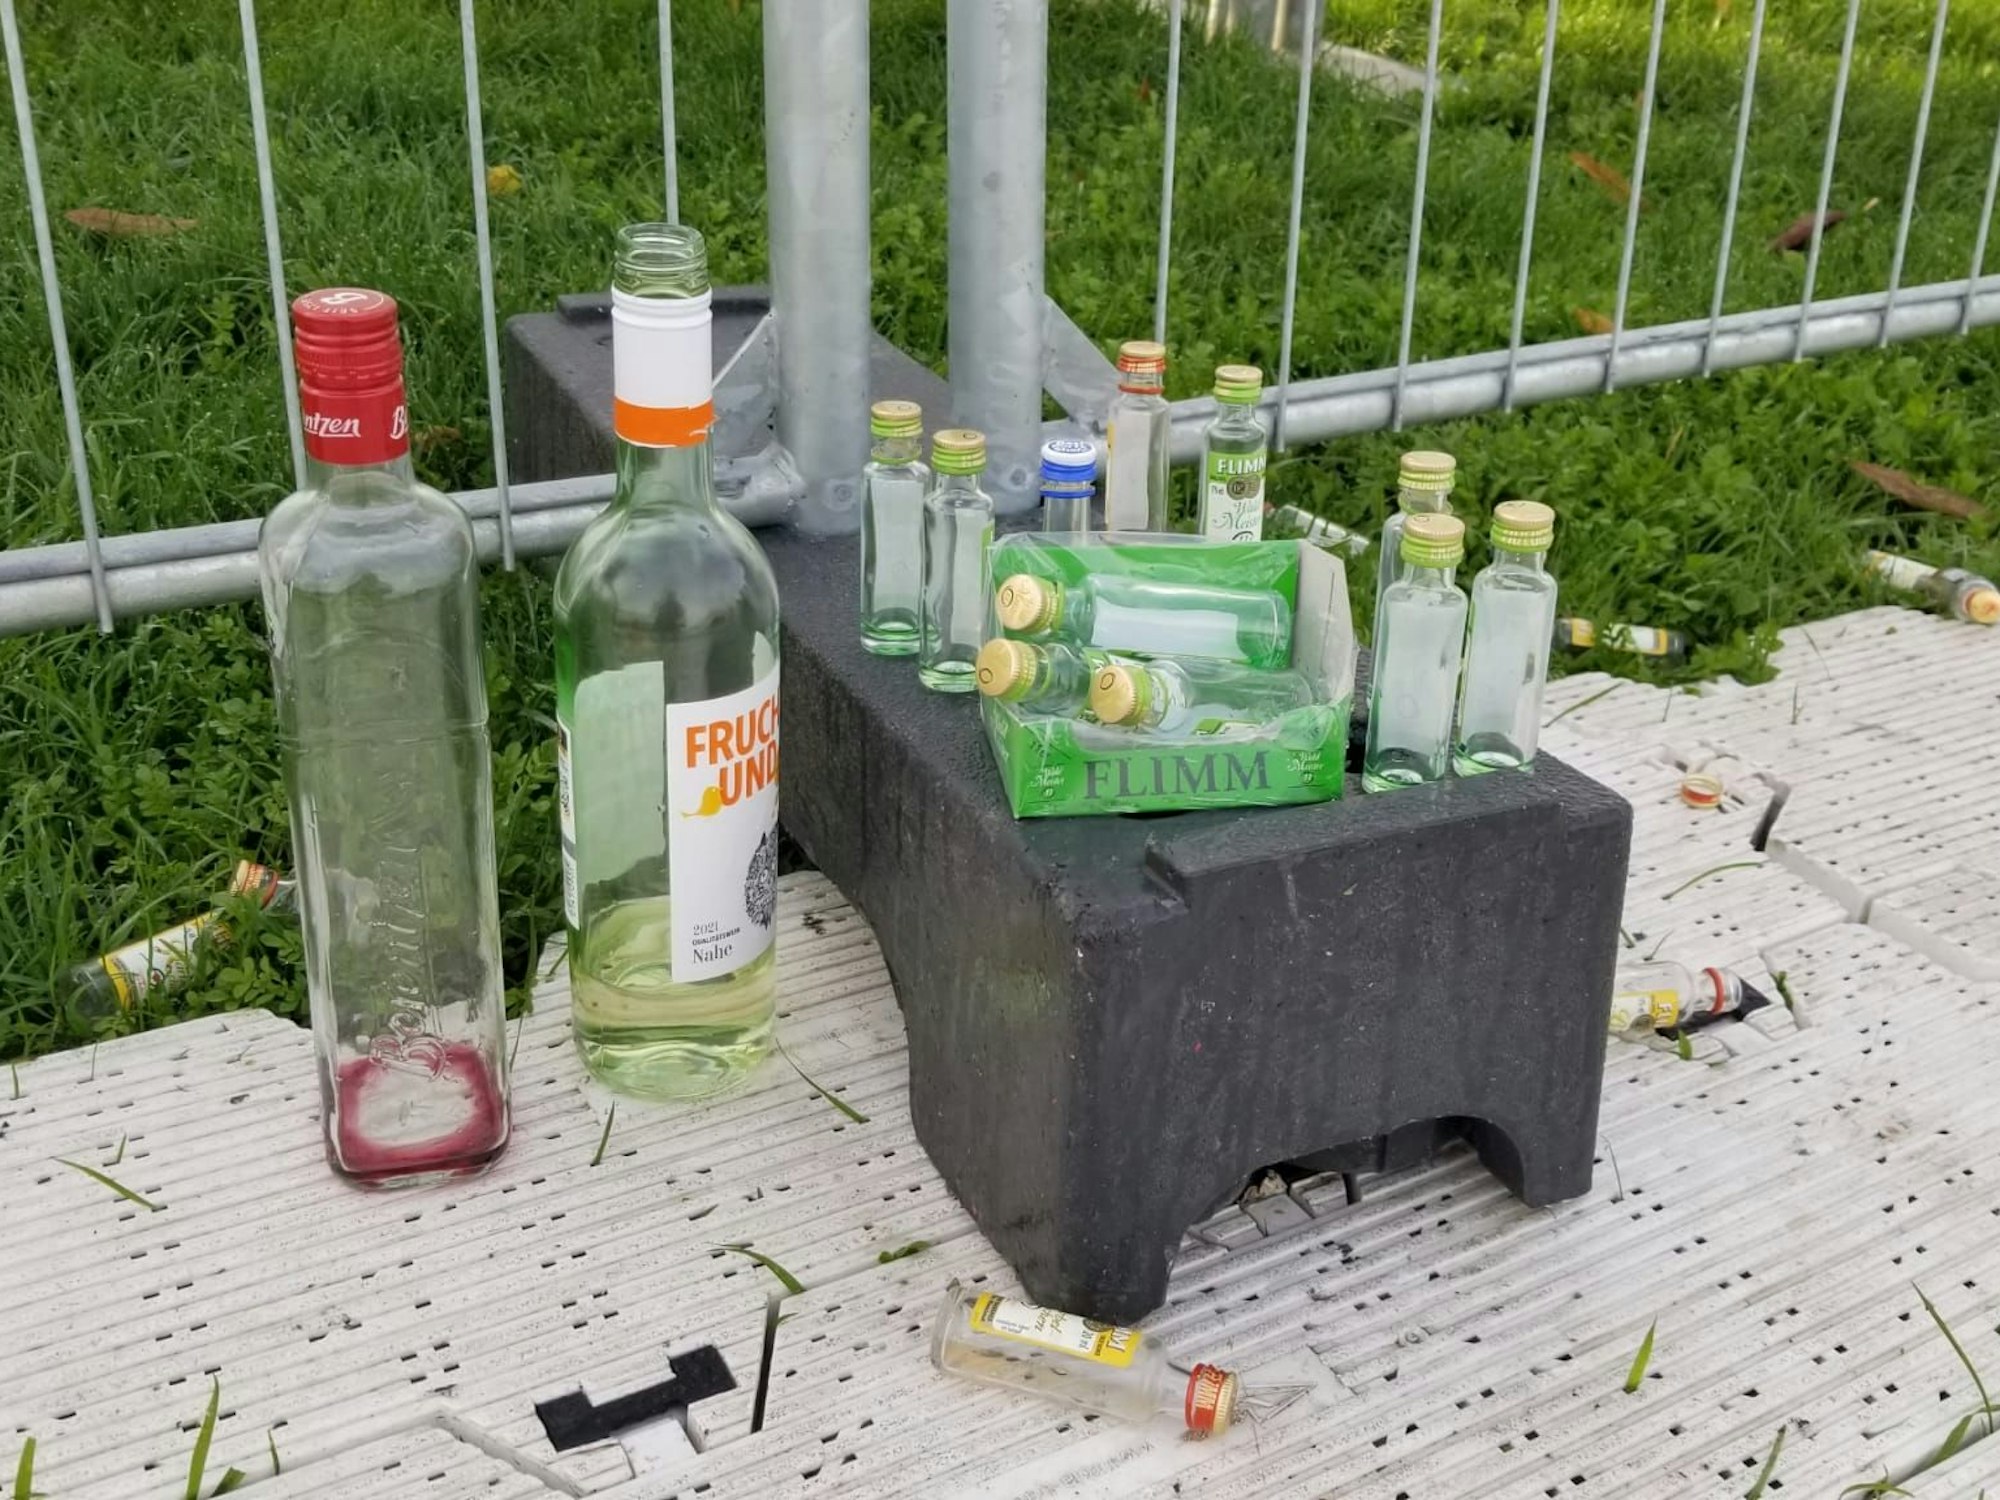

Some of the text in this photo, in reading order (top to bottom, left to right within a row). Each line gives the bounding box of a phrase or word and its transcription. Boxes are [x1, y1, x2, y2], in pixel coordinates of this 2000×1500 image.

[1217, 455, 1266, 474] FLIMM
[686, 694, 780, 768] FRUCH
[719, 740, 777, 806] UND
[1083, 751, 1271, 799] FLIMM
[693, 920, 718, 936] 2021
[693, 944, 733, 964] Nahe
